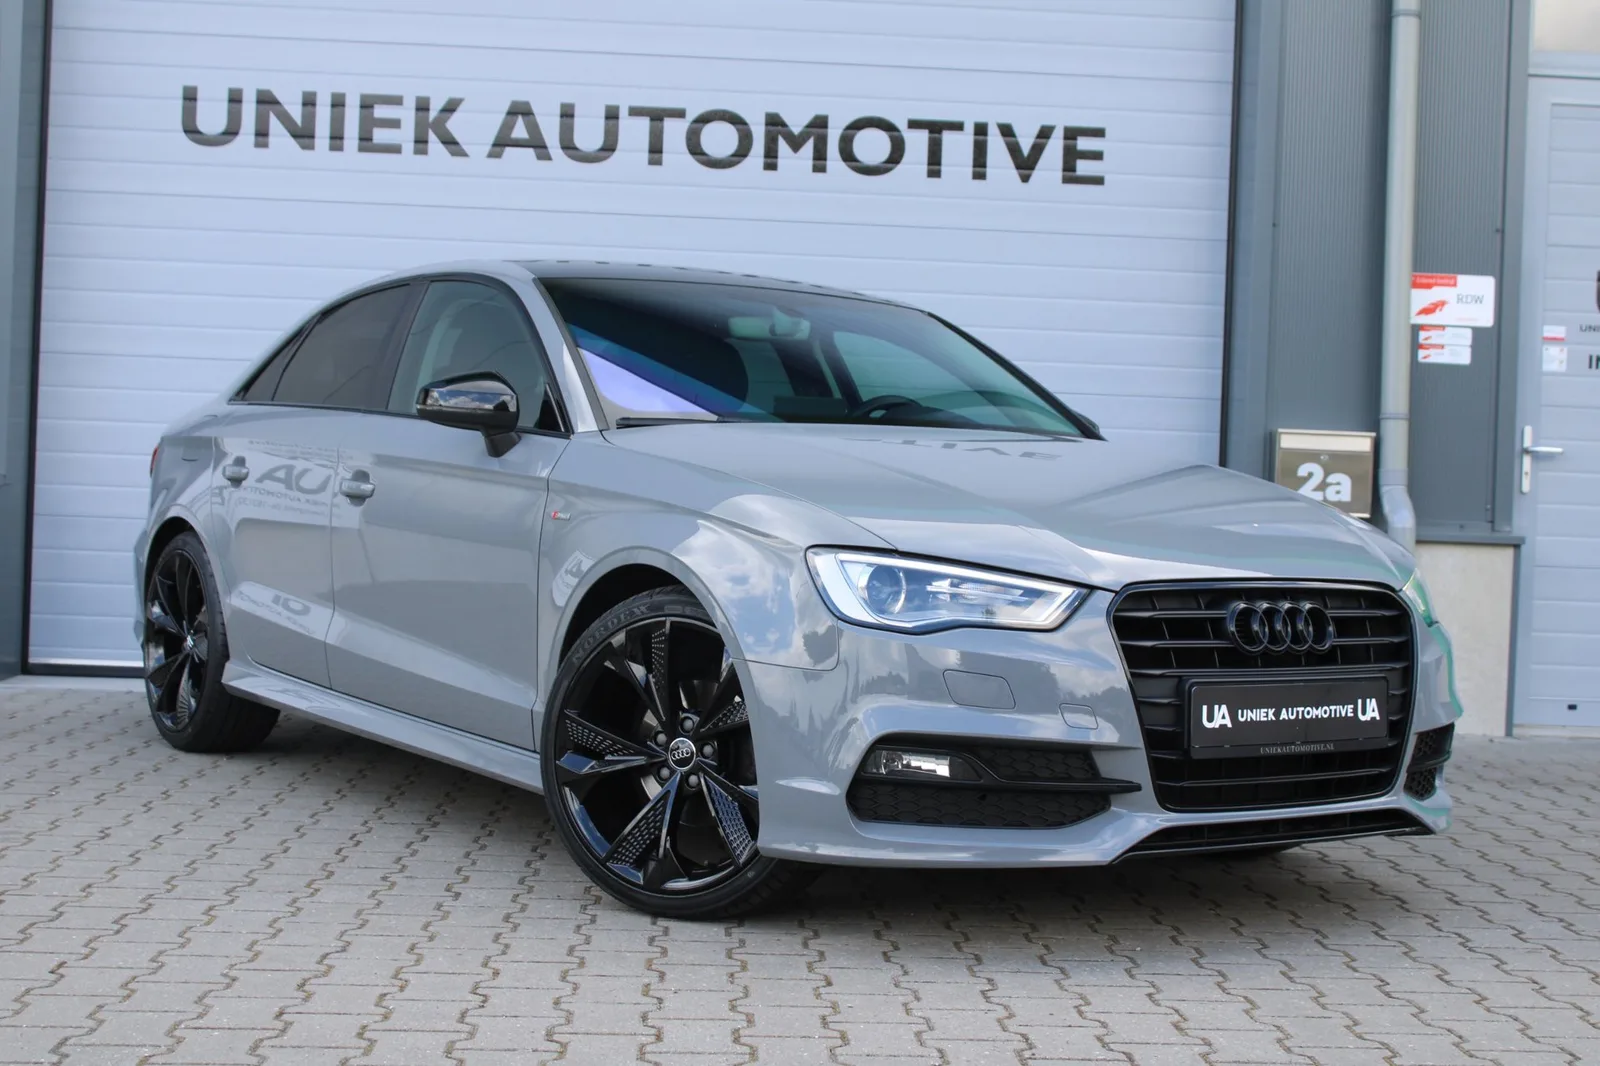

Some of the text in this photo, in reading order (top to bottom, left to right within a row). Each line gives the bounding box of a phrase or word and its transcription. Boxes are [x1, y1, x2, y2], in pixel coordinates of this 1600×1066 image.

[181, 85, 1107, 186] UNIEK AUTOMOTIVE
[1455, 293, 1485, 305] RDW
[1297, 462, 1352, 502] 2a
[1202, 698, 1380, 728] UA UNIEK AUTOMOTIVE UA
[1260, 743, 1335, 754] UNIEKAUTOMOTIVE.NL
